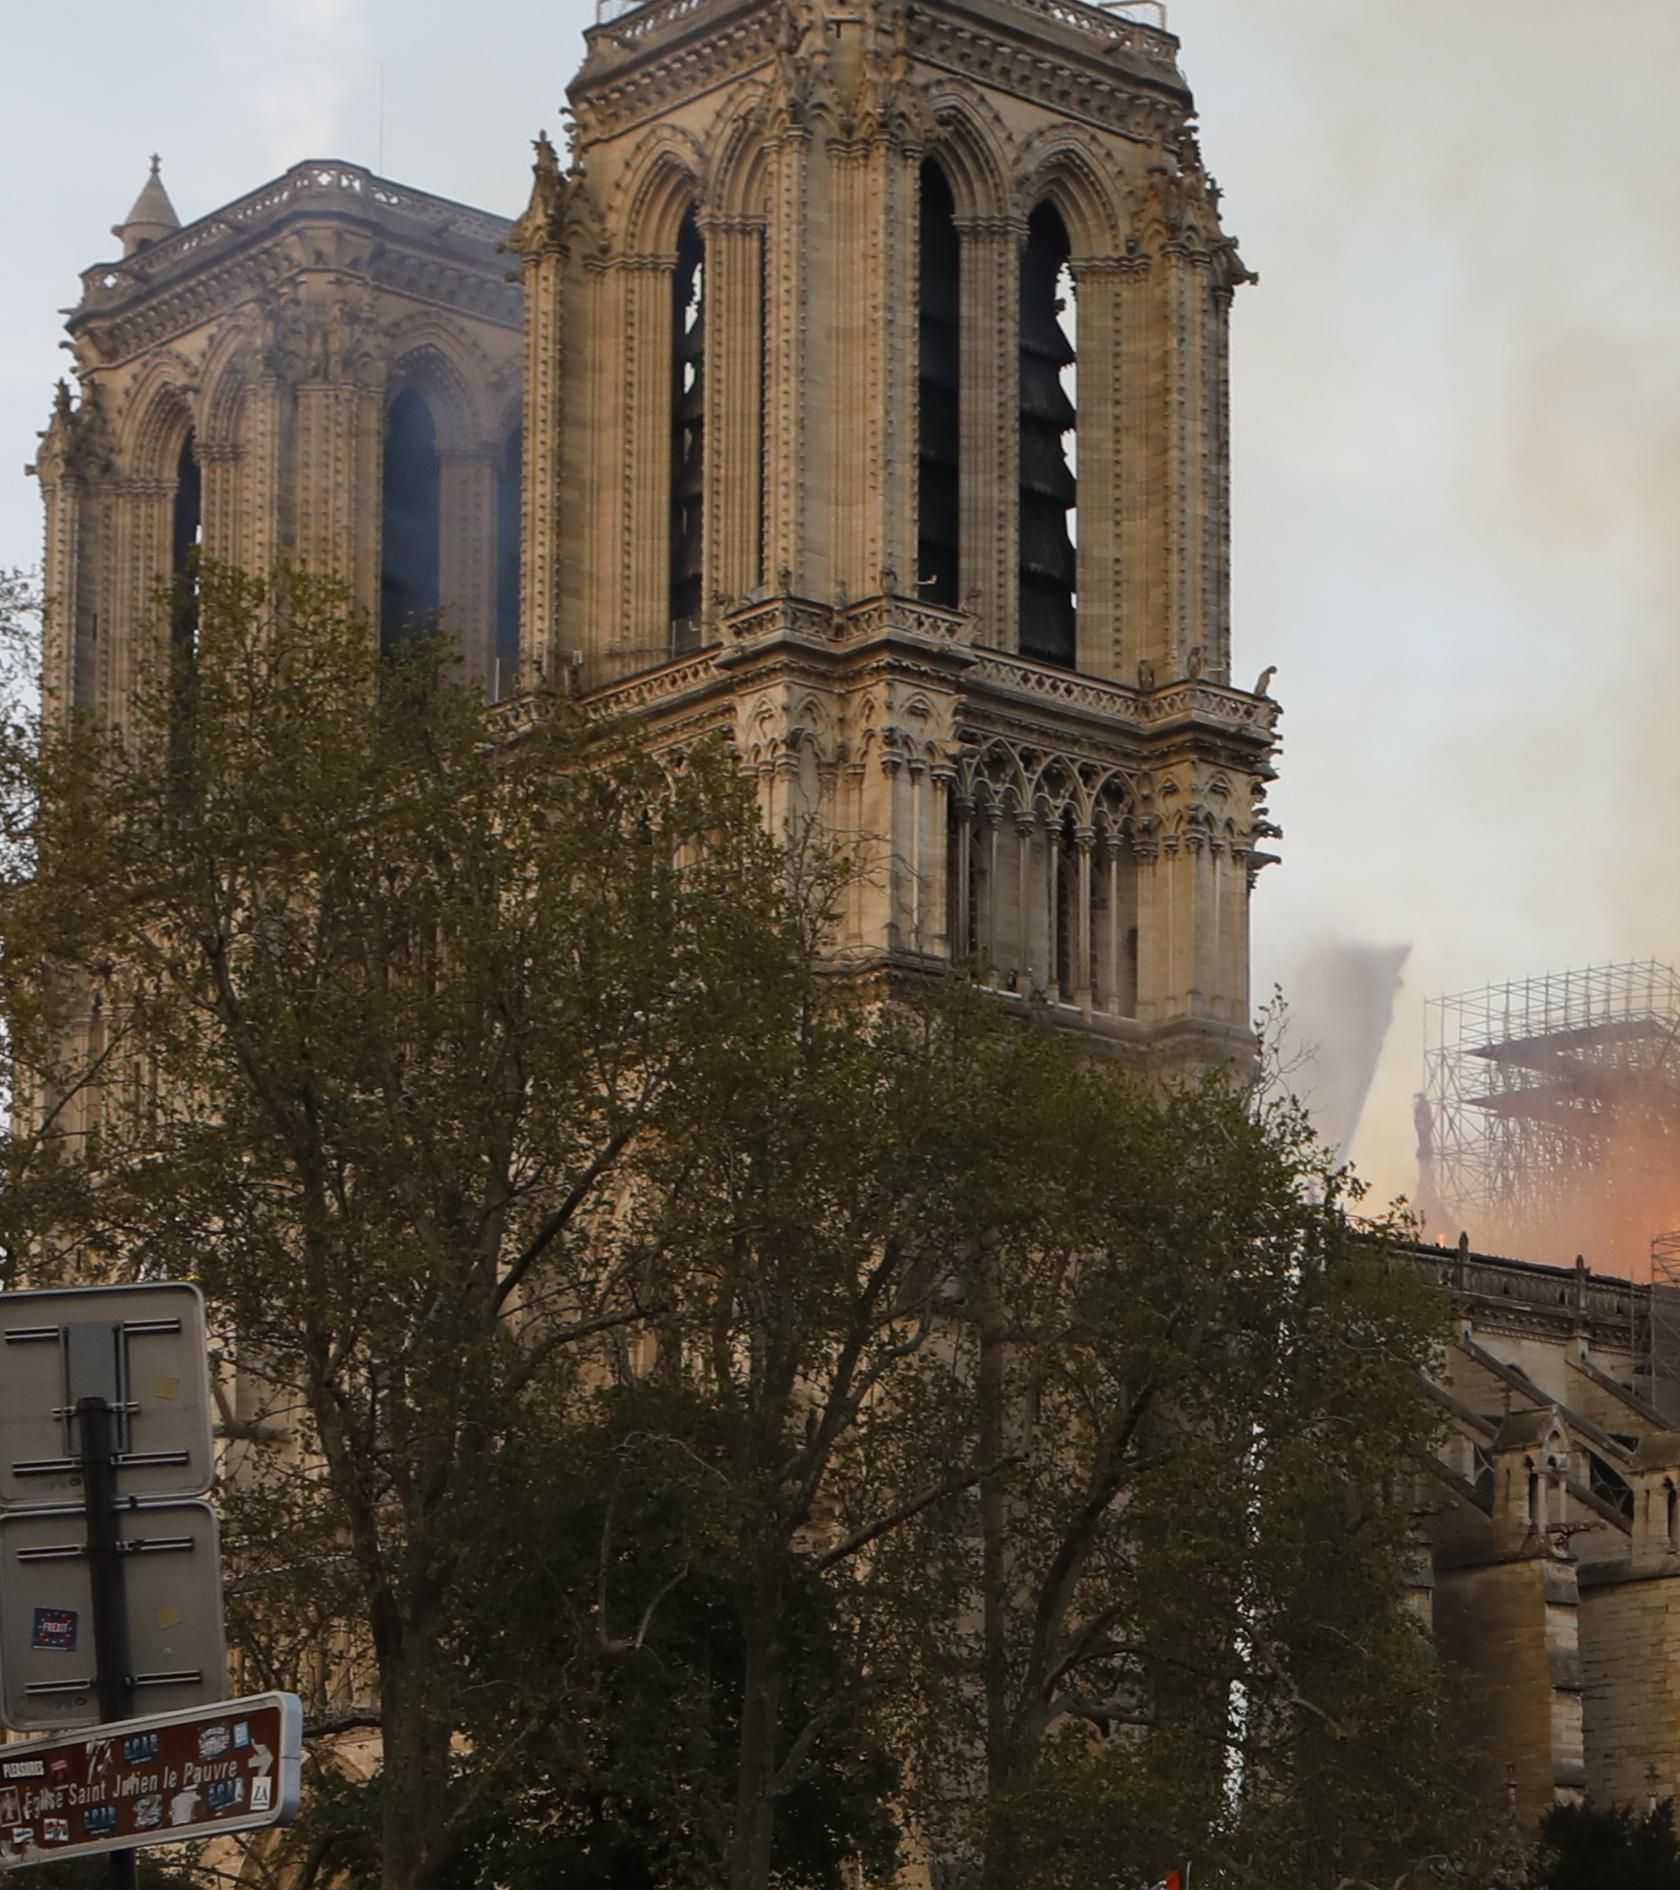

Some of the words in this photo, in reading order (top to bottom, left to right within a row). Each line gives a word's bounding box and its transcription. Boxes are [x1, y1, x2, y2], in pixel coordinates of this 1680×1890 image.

[43, 1622, 67, 1633] FREXIT
[69, 1780, 106, 1806] Saint
[112, 1771, 158, 1799] Julien
[163, 1765, 178, 1790] le
[183, 1760, 238, 1786] Pauvre
